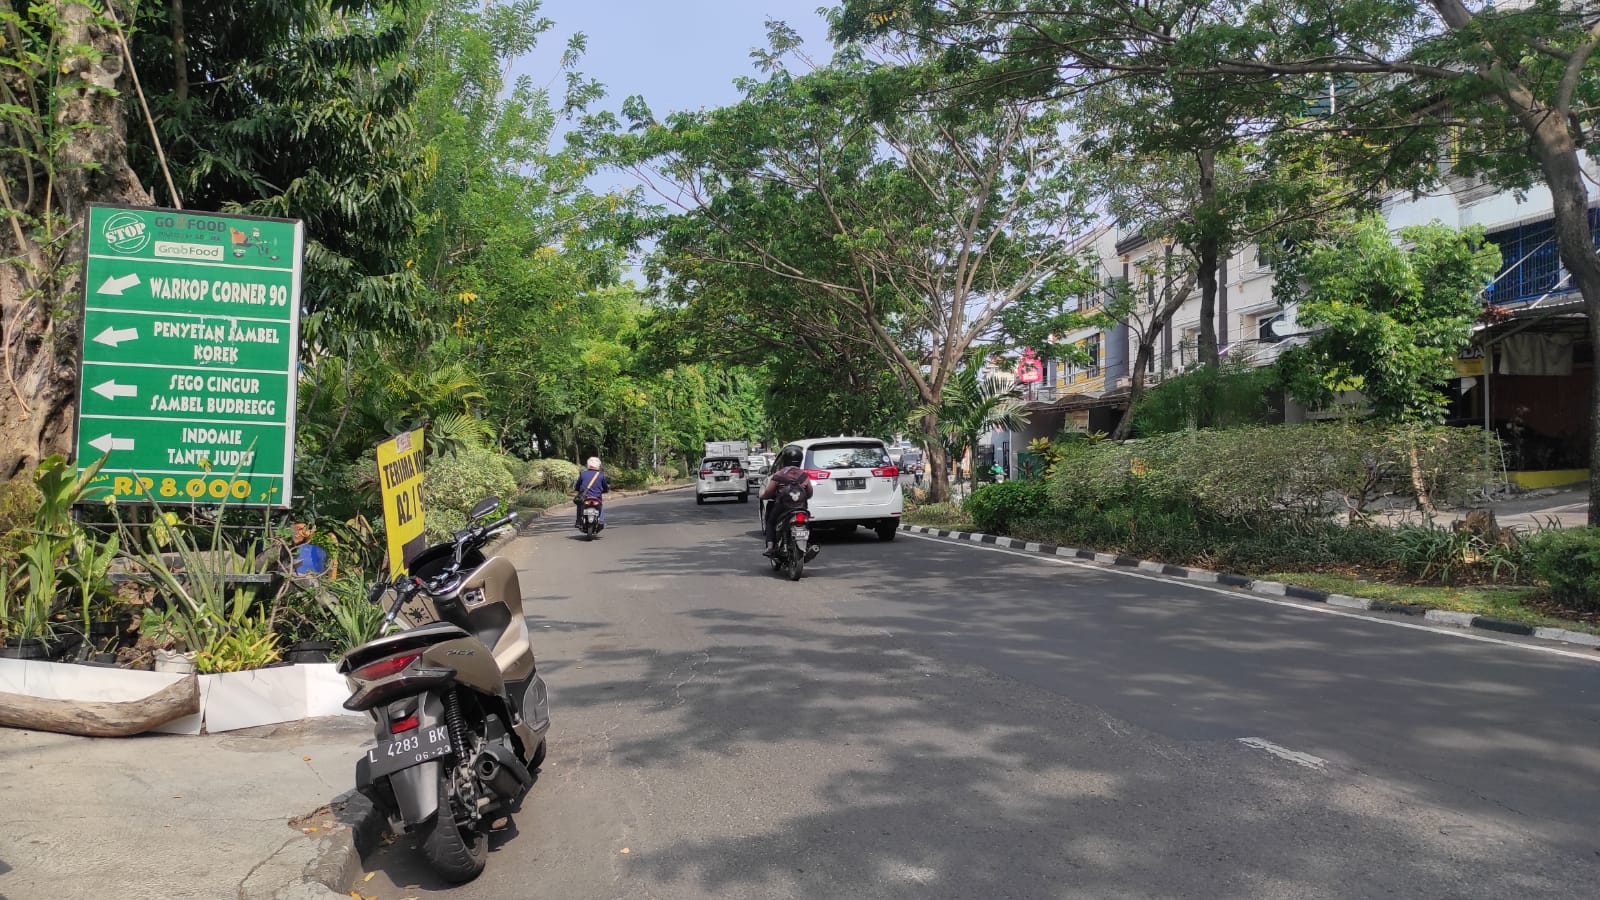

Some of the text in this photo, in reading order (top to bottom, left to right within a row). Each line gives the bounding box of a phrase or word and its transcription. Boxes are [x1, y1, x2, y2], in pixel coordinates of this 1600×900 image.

[105, 222, 146, 244] STOP
[158, 245, 219, 257] GrabFood
[150, 277, 287, 306] WARKOP CORNER 90
[154, 321, 279, 344] PENYETAN SAMBEL
[193, 344, 238, 362] KOREK
[169, 374, 260, 394] SEGO CINGUR
[151, 395, 275, 416] SAMBEL BUDREEGG
[182, 427, 242, 445] INDOMIE
[382, 454, 416, 489] TERIMA
[114, 476, 154, 496] RP
[396, 491, 412, 526] A2
[369, 727, 446, 763] L 4283 BK
